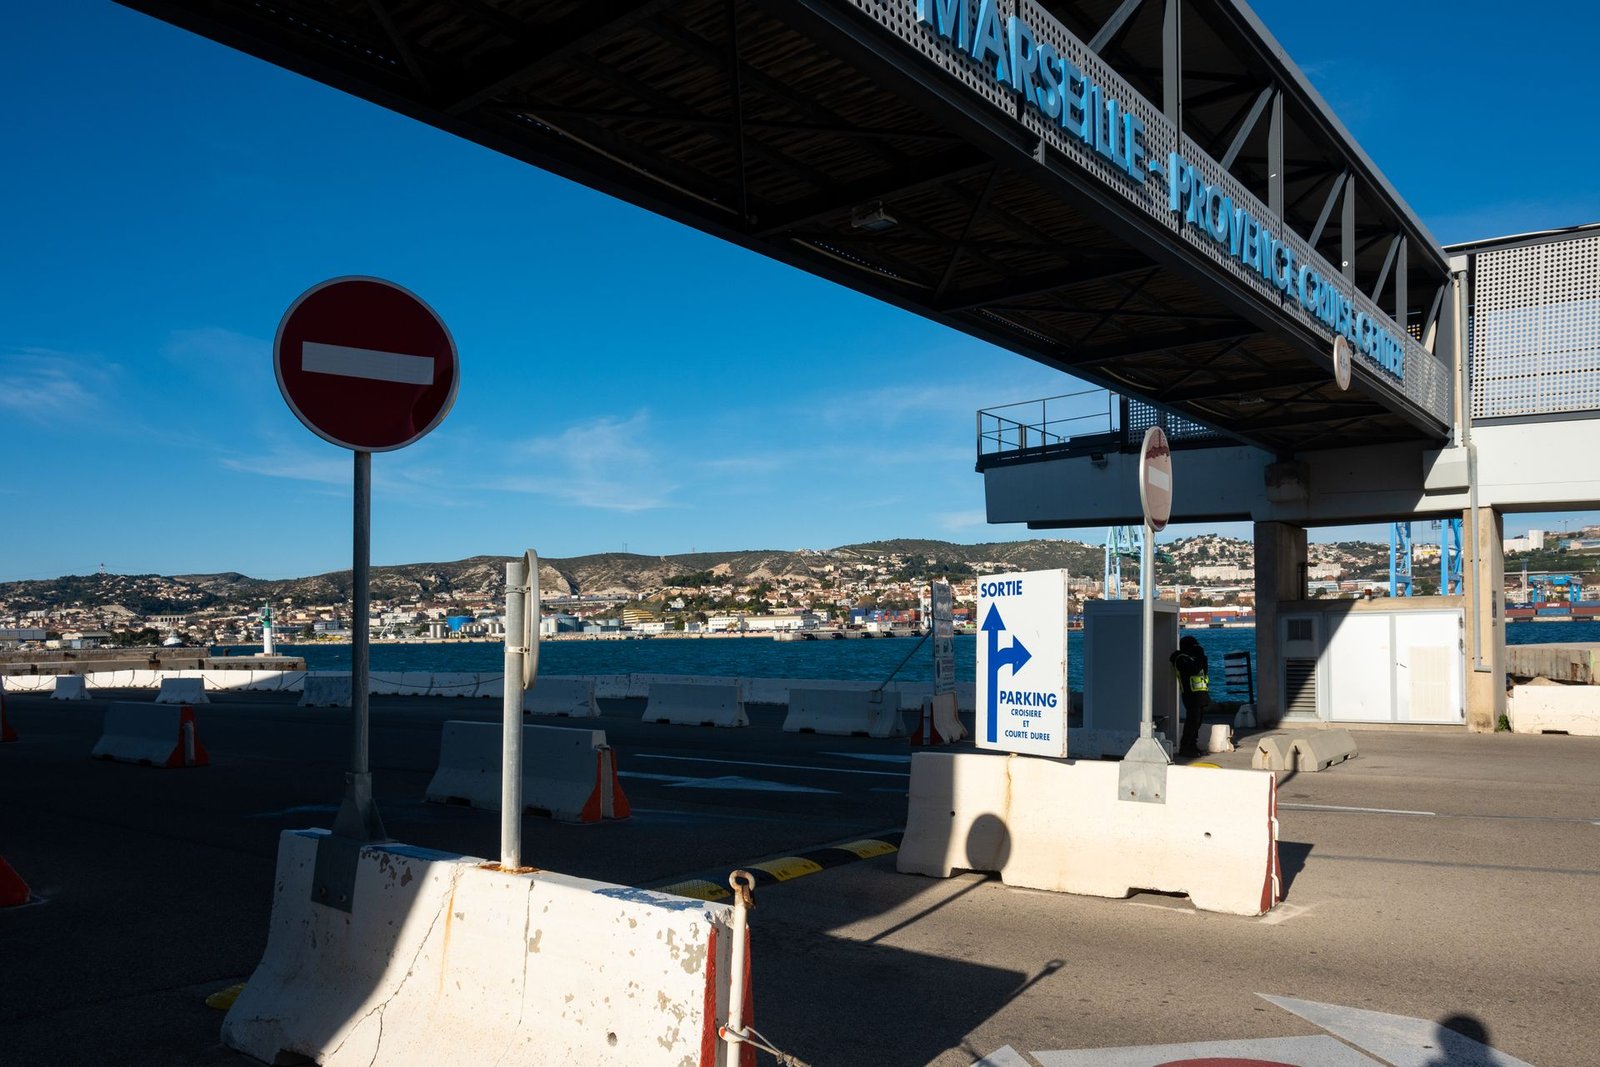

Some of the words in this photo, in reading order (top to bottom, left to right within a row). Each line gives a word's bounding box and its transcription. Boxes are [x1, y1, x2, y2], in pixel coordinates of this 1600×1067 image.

[1169, 151, 1299, 296] PROVENCE
[1299, 265, 1356, 344] CRUISE
[1356, 311, 1405, 381] CENTER
[981, 580, 1023, 598] SORTIE
[1000, 690, 1058, 708] PARKING
[1010, 708, 1042, 718] CROISIERE
[1022, 720, 1030, 728] ET
[1004, 729, 1028, 739] COURTE
[1030, 731, 1051, 741] DUREE
